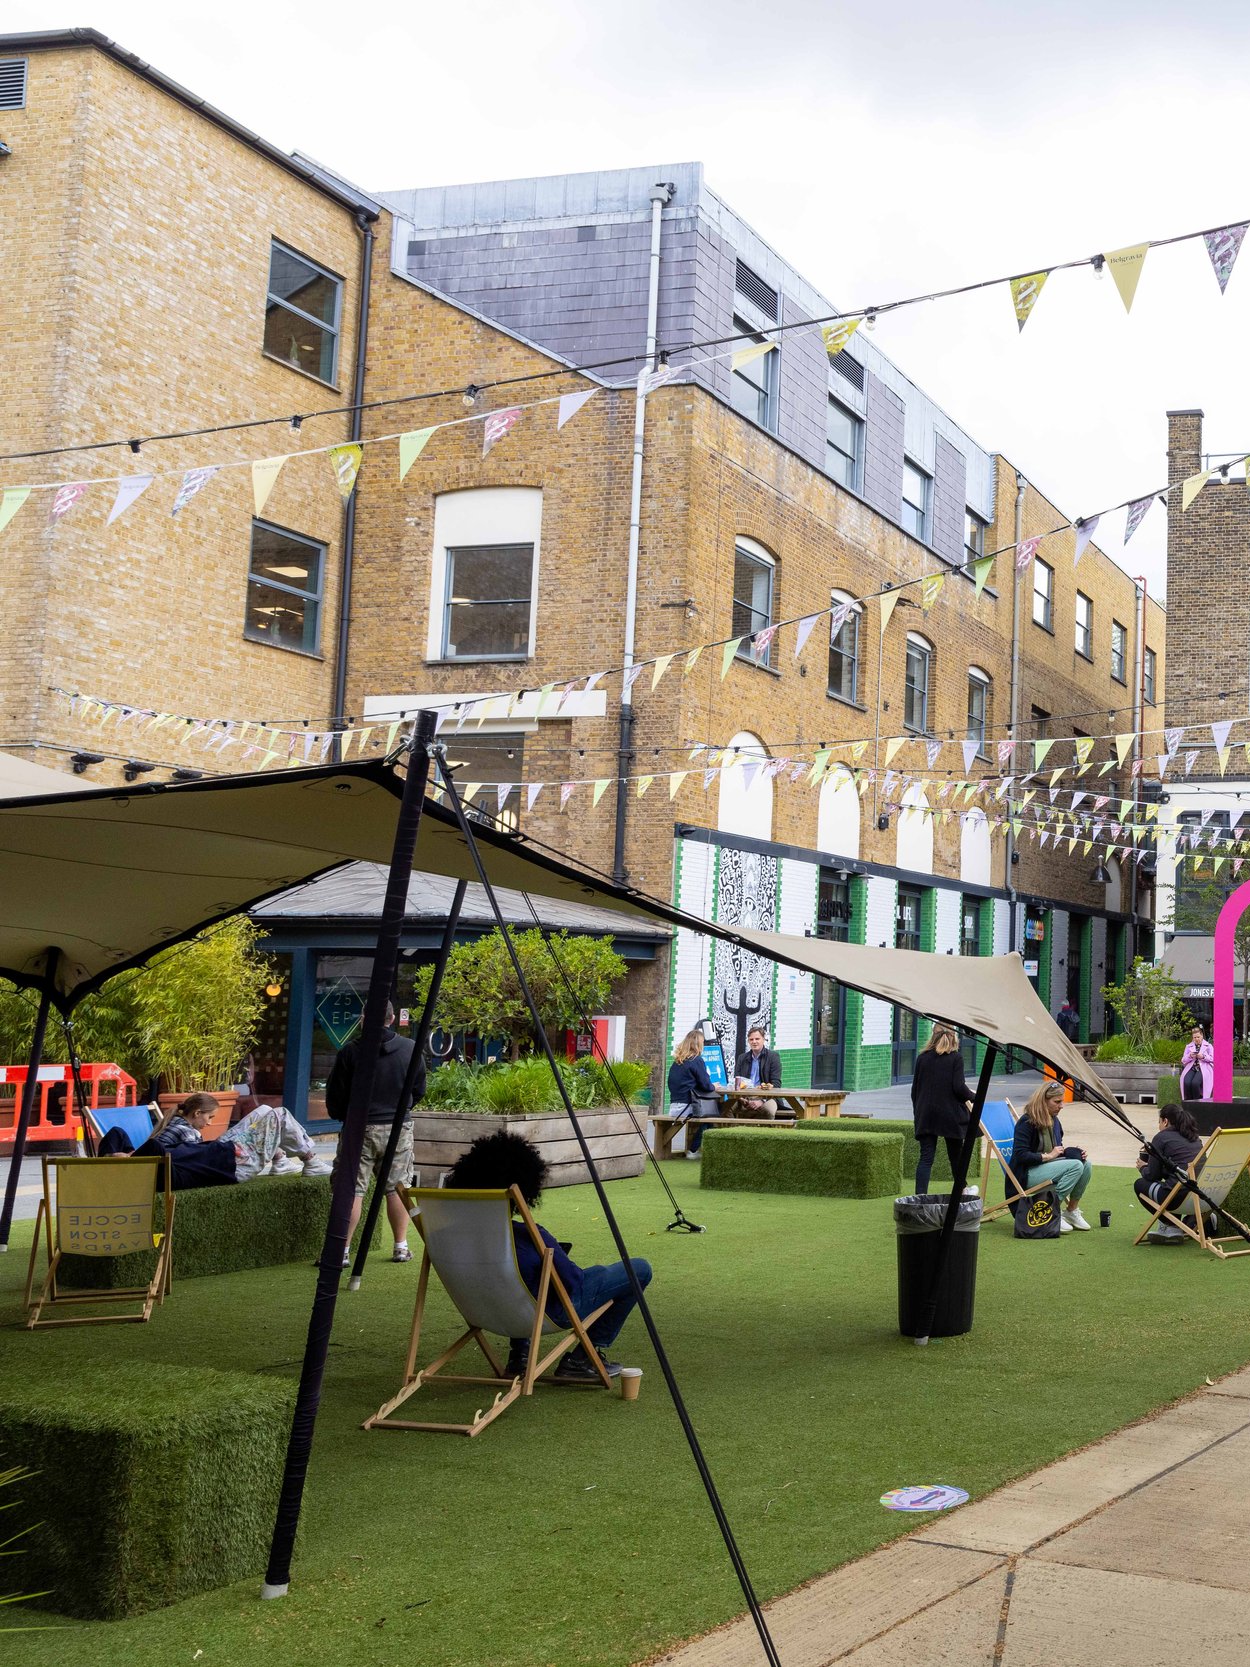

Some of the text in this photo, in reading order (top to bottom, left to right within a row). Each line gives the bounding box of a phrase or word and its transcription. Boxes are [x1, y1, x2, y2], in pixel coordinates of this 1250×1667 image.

[1110, 253, 1143, 264] Belgravia
[1190, 988, 1209, 997] JONES
[334, 992, 352, 1006] 25
[332, 1011, 352, 1025] EP
